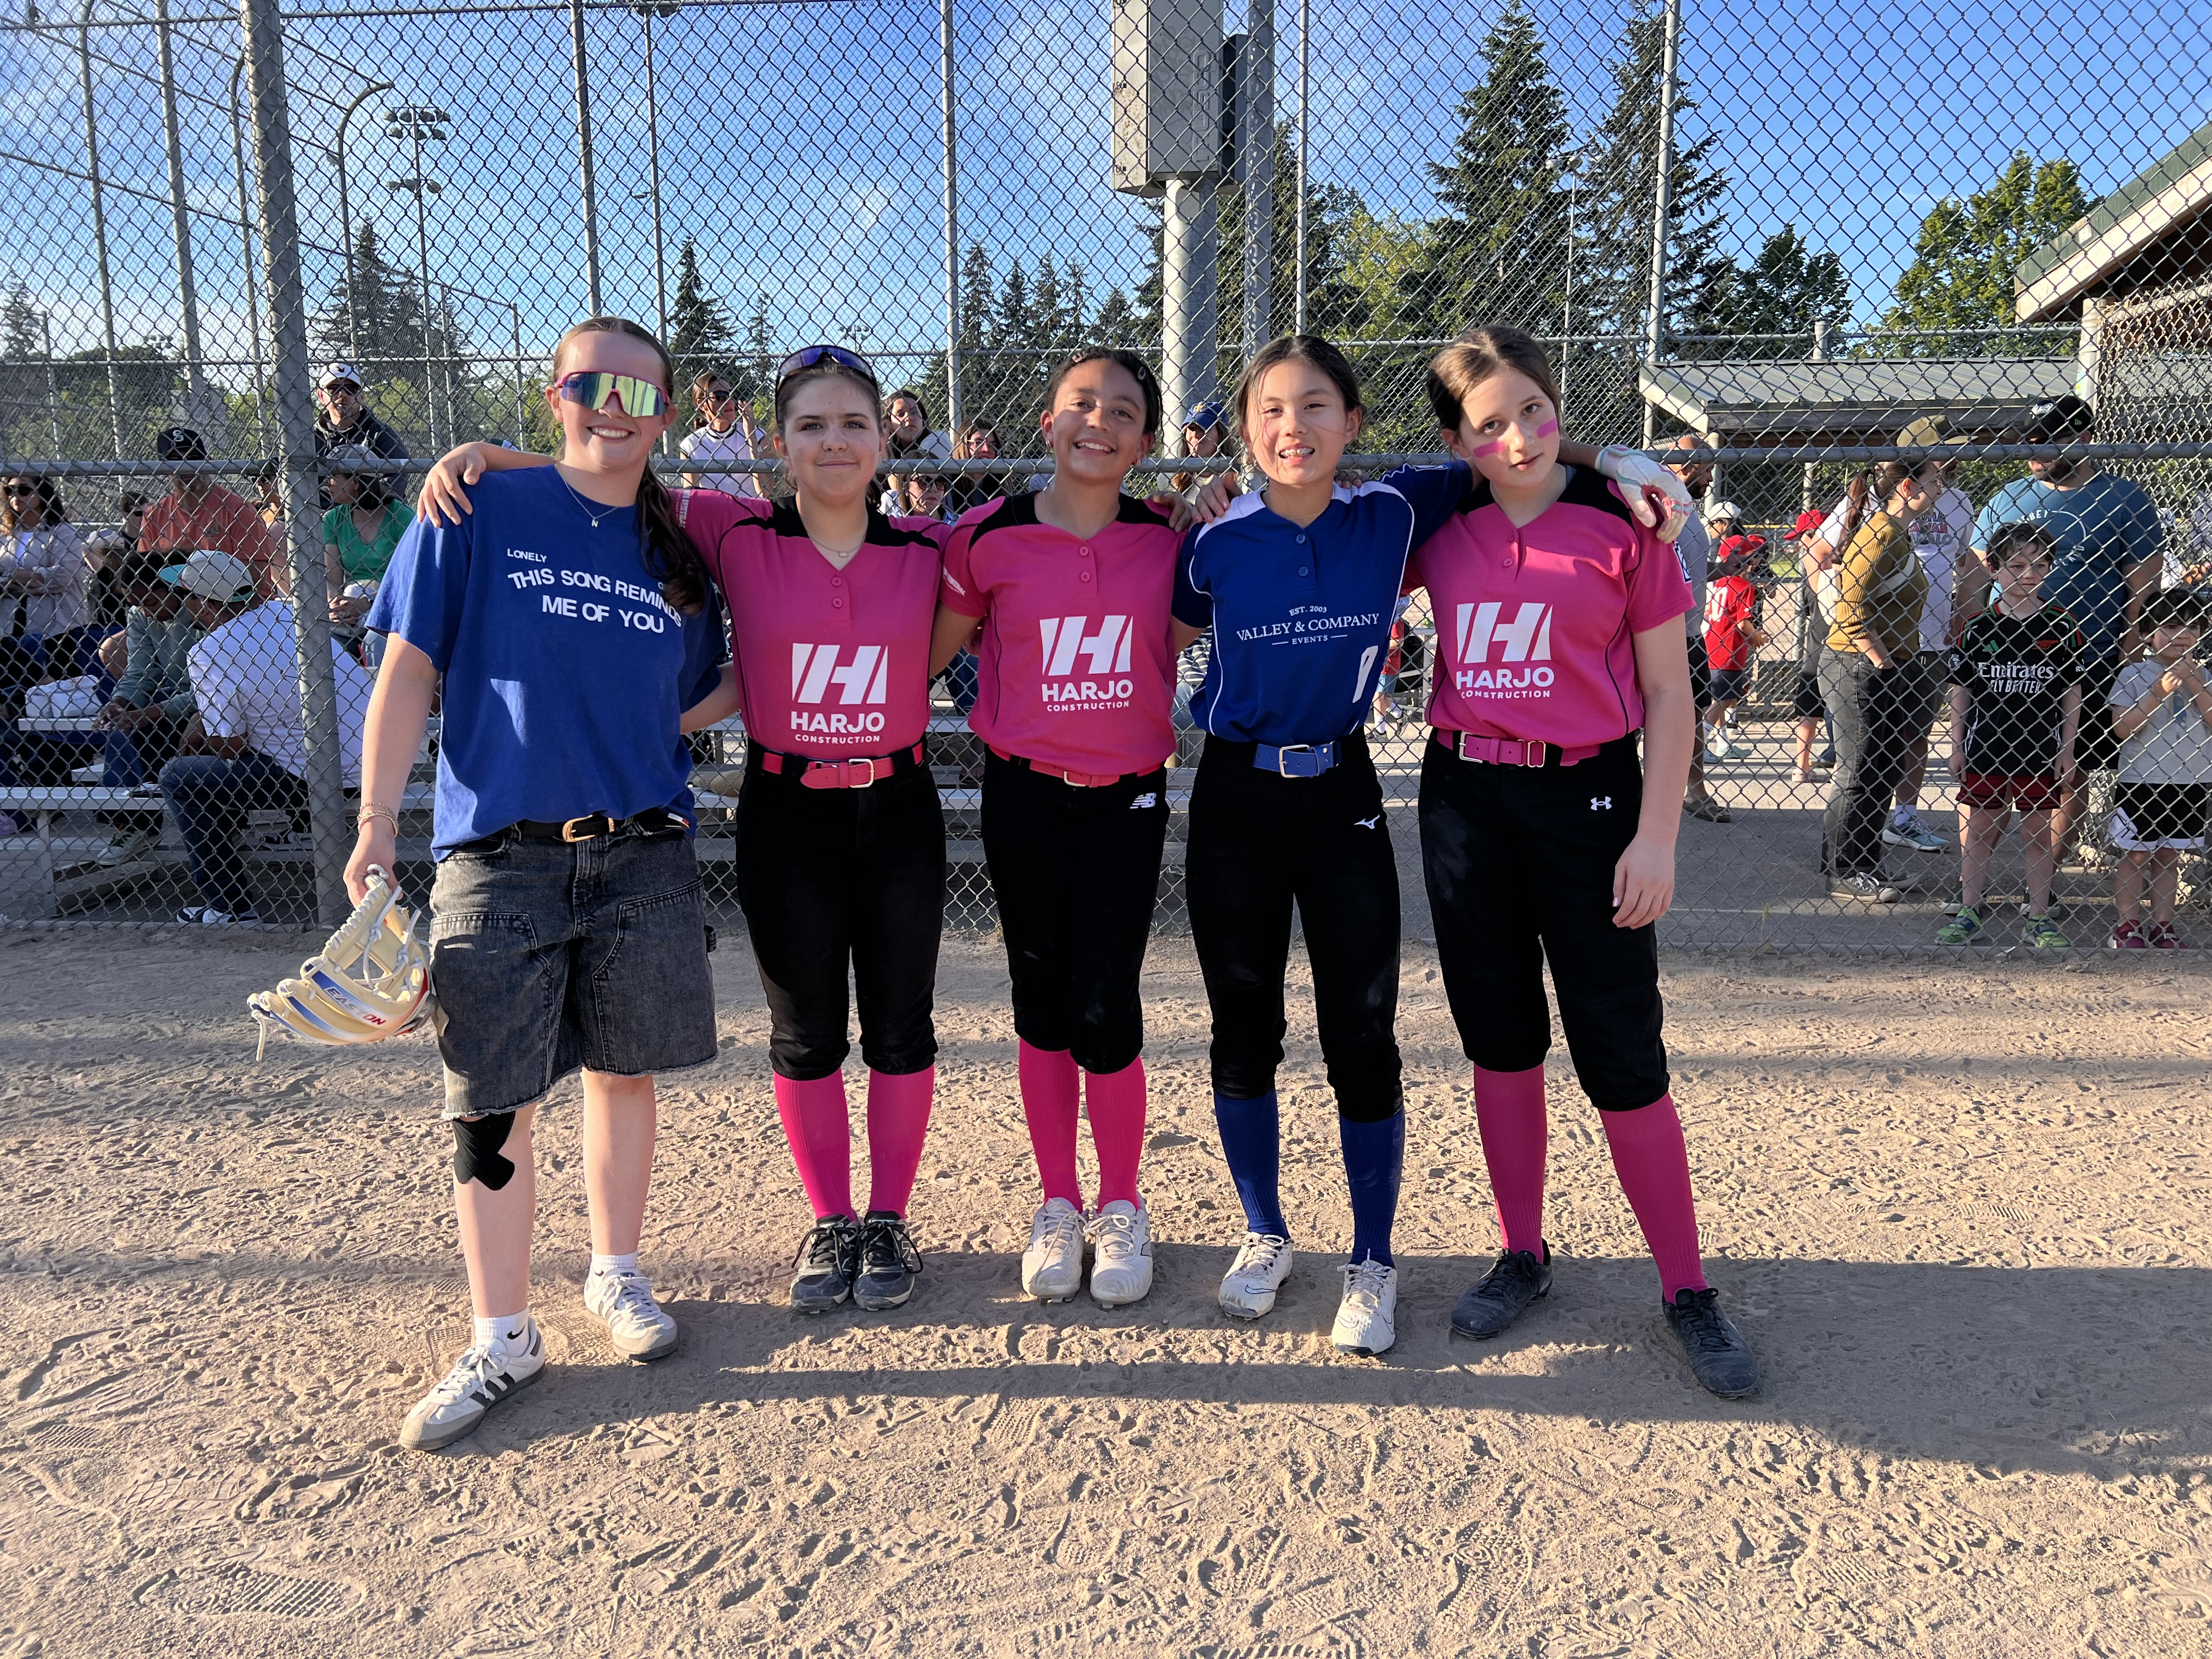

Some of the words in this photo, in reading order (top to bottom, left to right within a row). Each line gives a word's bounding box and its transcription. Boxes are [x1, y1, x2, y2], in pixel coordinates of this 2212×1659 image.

[507, 549, 547, 563] LONELY
[507, 568, 555, 590] THIS
[560, 569, 611, 593] SONG
[614, 580, 682, 628] REMINDS
[542, 595, 577, 618] ME
[582, 603, 610, 622] OF
[618, 609, 664, 634] YOU
[1289, 606, 1307, 617] EST.
[1236, 622, 1291, 641] VALLEY
[1294, 621, 1305, 633] &
[1308, 613, 1379, 631] COMPANY
[1292, 634, 1328, 645] EVENTS
[1456, 667, 1555, 690] HARJO
[1978, 662, 2054, 679] Emirates
[1041, 679, 1133, 702] HARJO
[1461, 690, 1550, 699] CONSTRUCTION
[1047, 701, 1130, 712] CONSTRUCTION
[791, 711, 885, 733] HARJO
[795, 734, 881, 744] CONSTRUCTION
[324, 986, 386, 1025] EASTON
